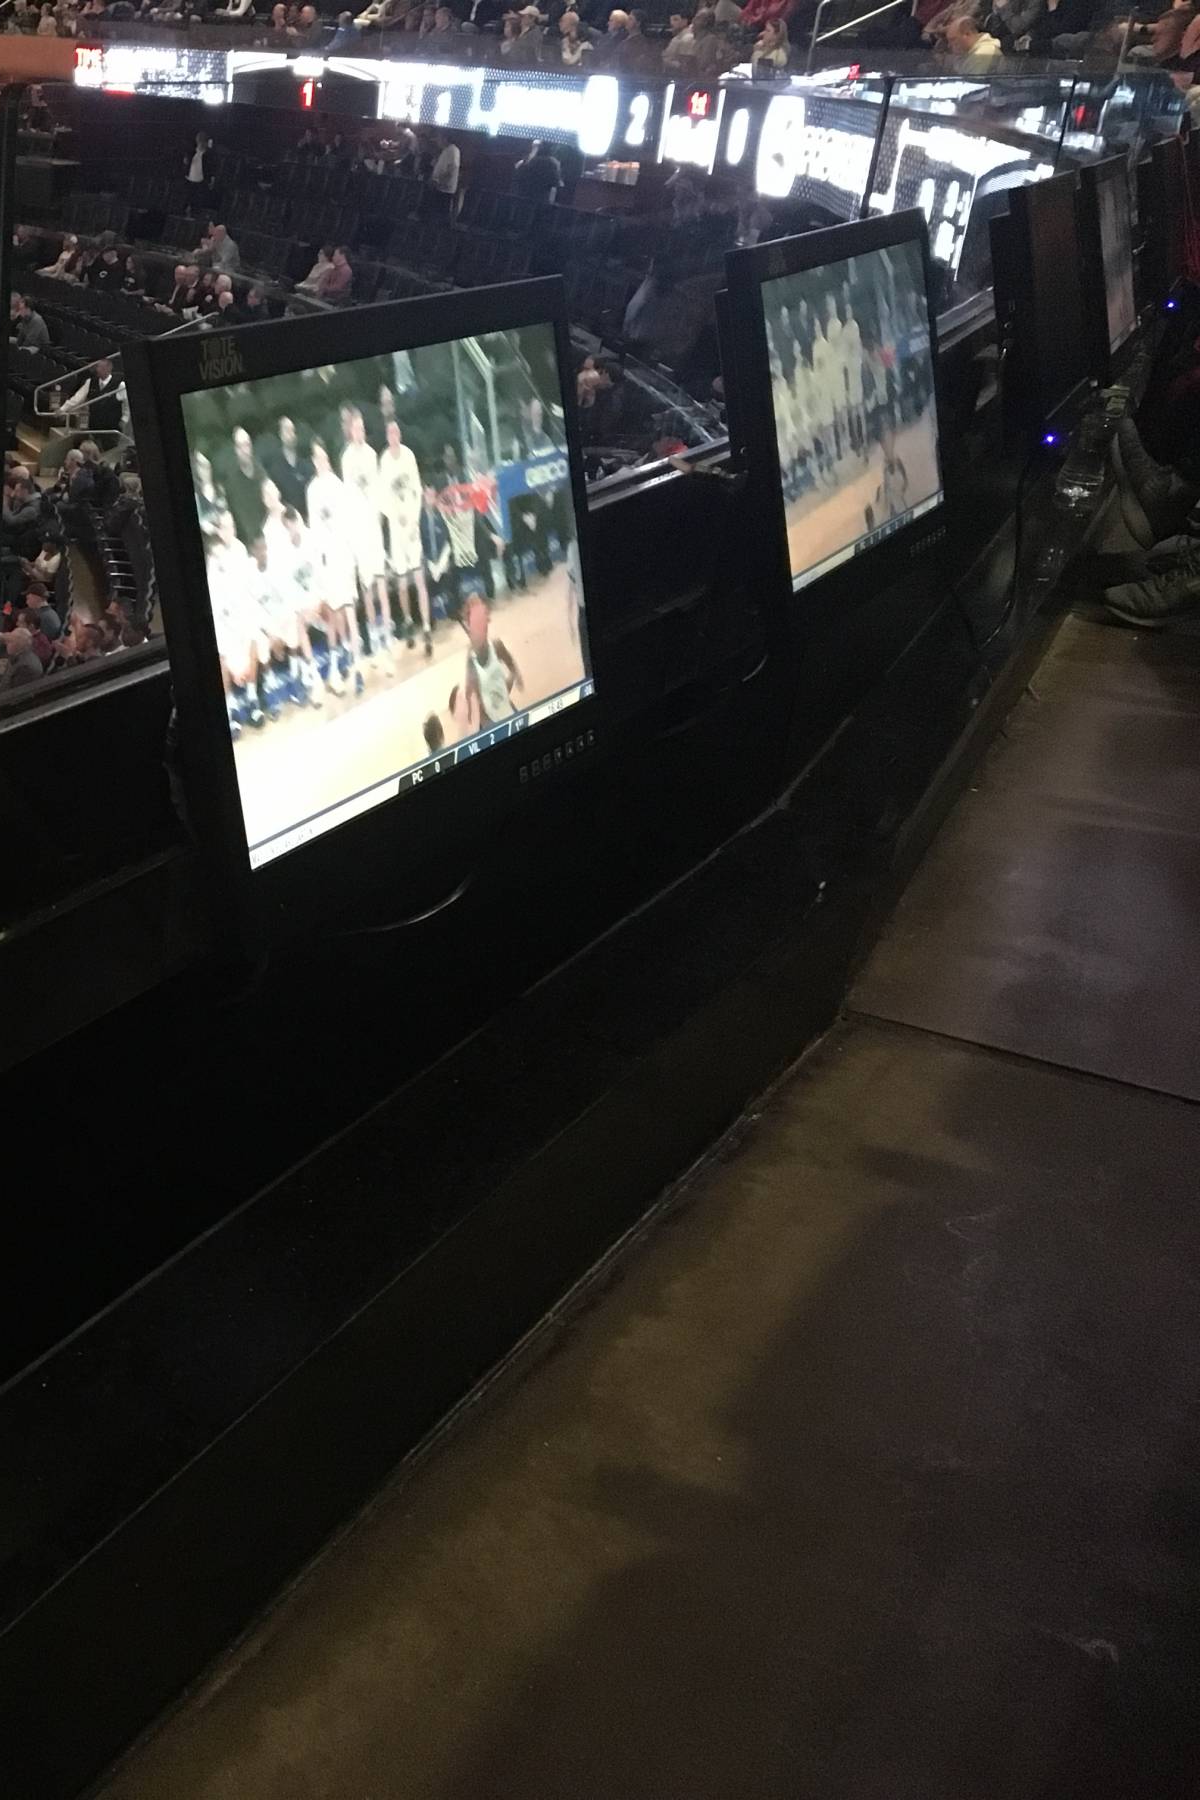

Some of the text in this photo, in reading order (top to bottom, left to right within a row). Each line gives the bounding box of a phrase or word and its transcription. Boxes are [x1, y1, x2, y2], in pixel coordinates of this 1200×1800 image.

[199, 353, 243, 381] VISION
[468, 733, 496, 755] VIL 2
[412, 770, 424, 785] PC
